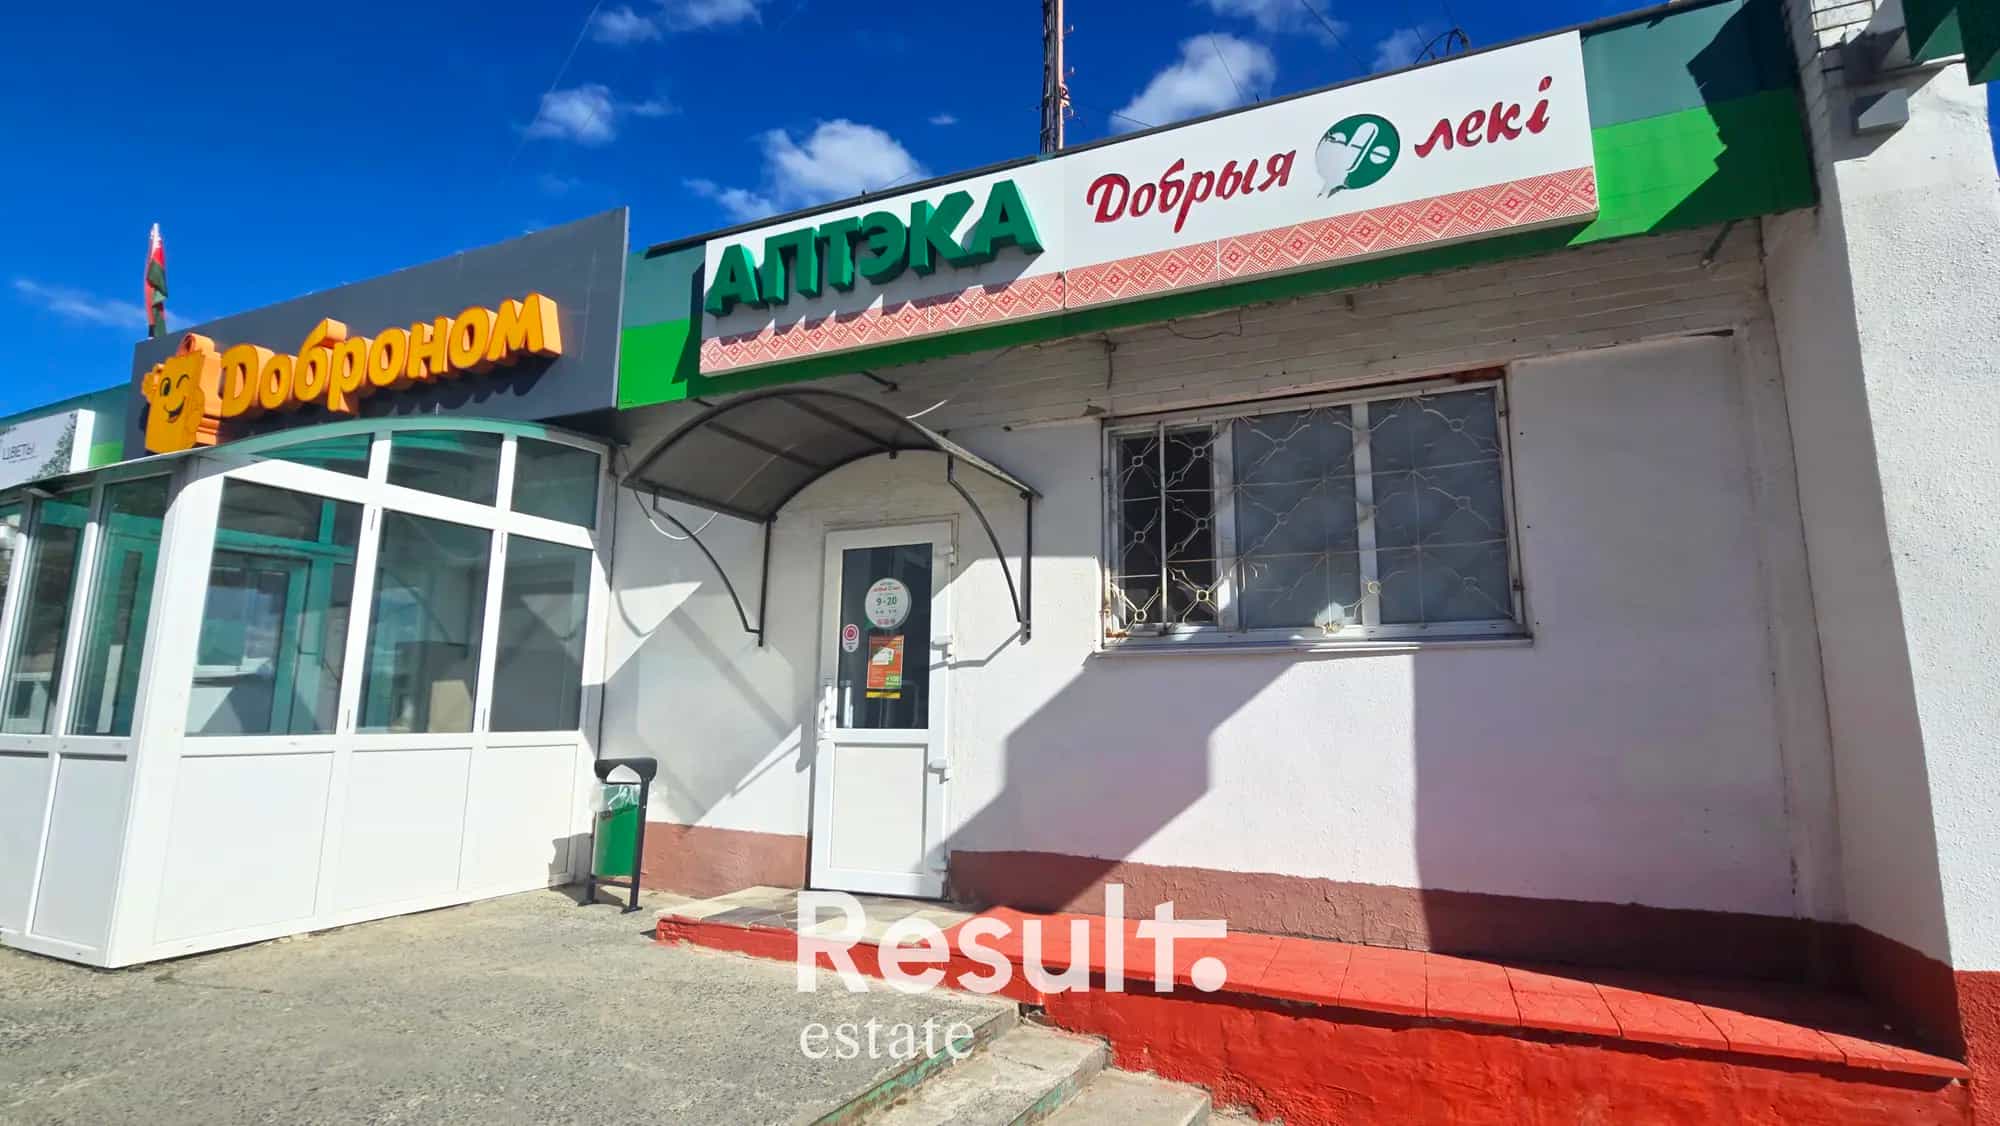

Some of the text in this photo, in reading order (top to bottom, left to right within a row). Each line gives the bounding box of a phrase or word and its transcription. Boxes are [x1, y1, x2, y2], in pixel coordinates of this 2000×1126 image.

[1086, 75, 1553, 233] Добрыя лекі
[704, 179, 1044, 315] АПТЭКА
[219, 292, 561, 416] Доброном
